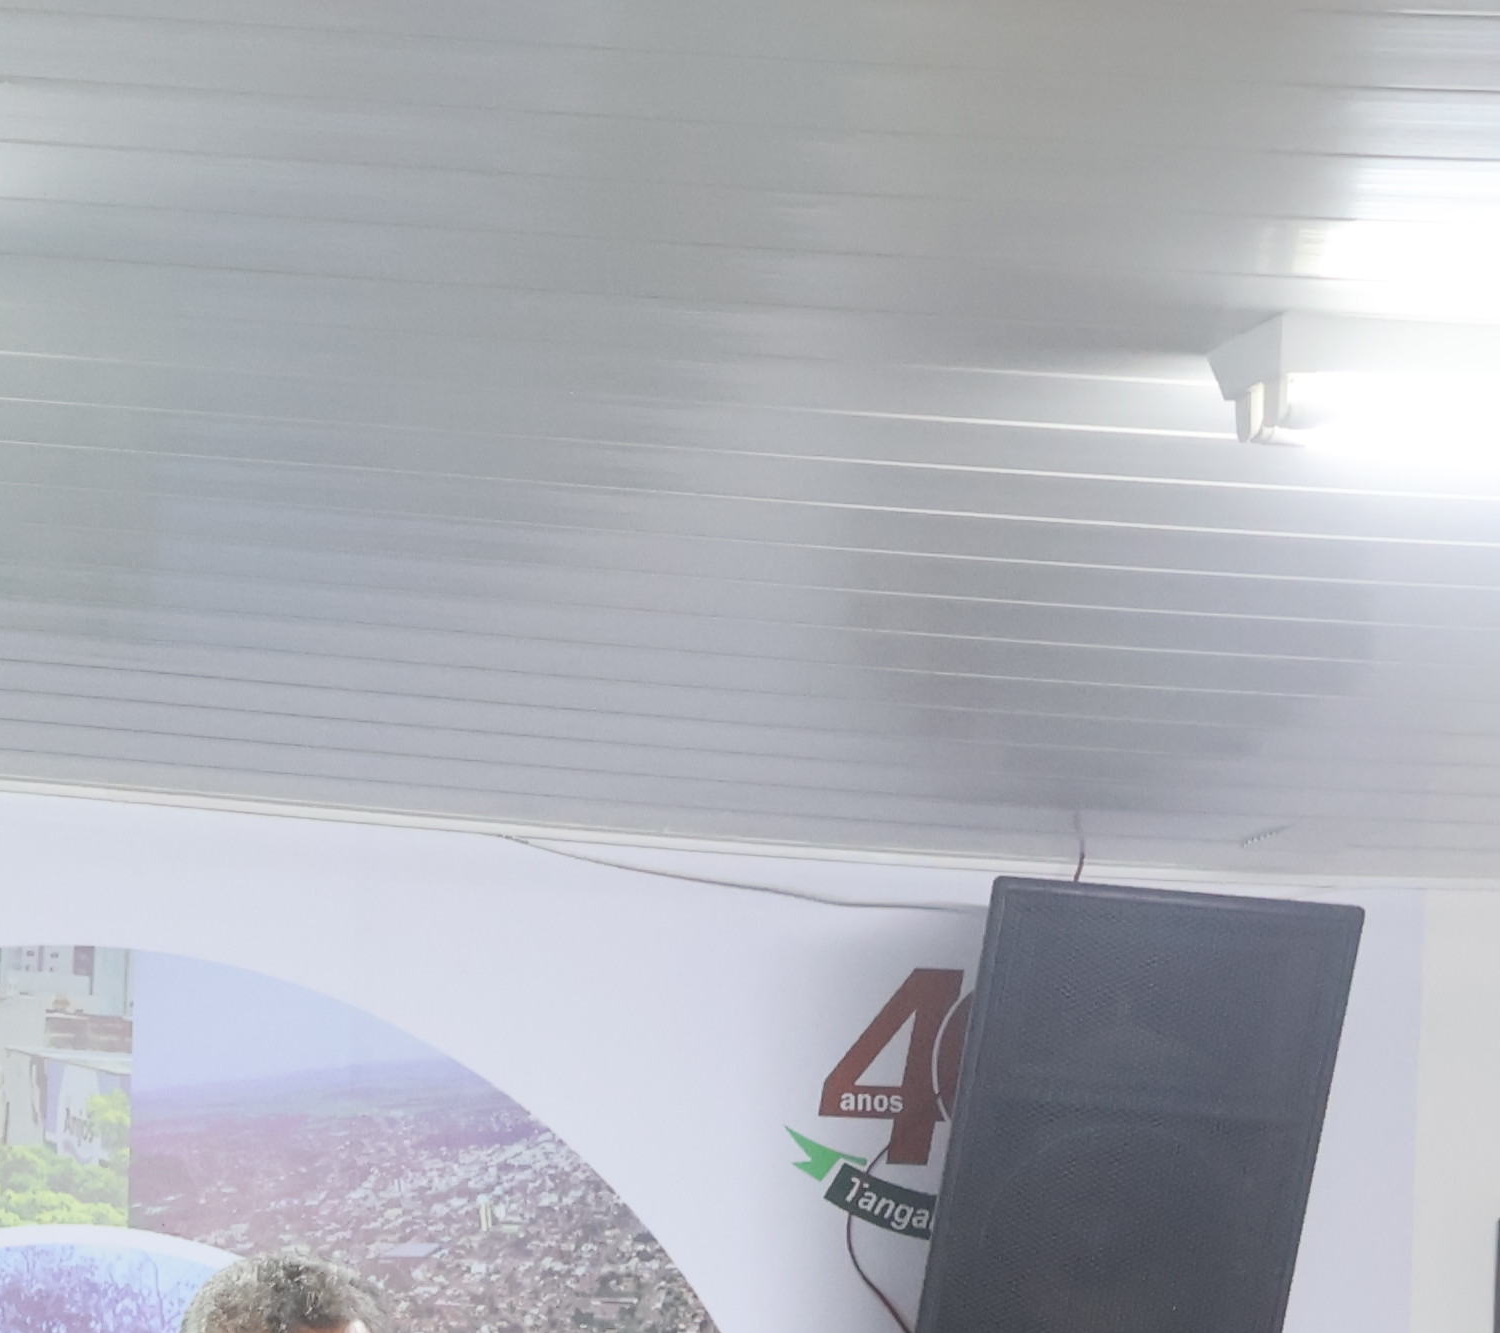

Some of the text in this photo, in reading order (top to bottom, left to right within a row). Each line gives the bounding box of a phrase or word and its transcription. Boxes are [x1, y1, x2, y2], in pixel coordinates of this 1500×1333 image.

[818, 967, 975, 1166] 4
[839, 1090, 904, 1114] anos
[845, 1176, 935, 1232] Tanga
